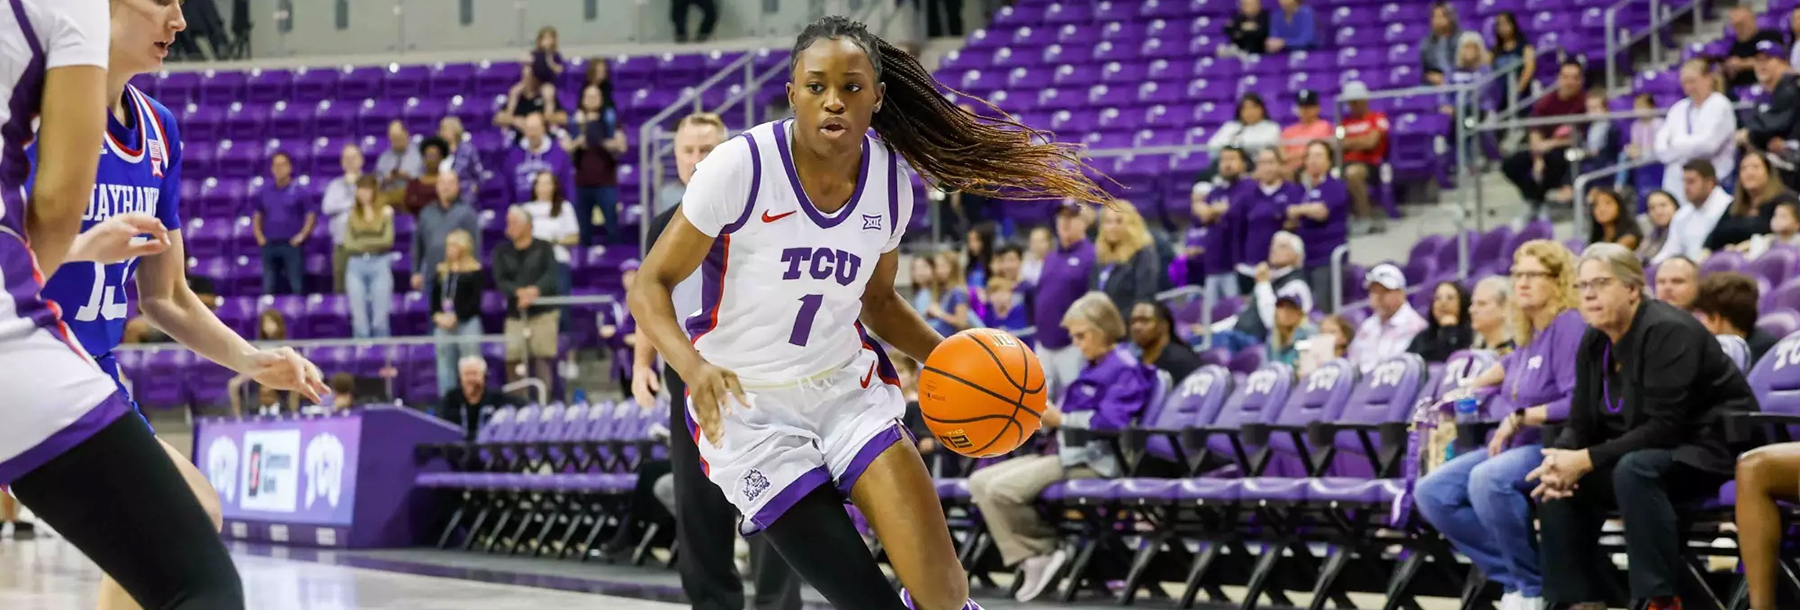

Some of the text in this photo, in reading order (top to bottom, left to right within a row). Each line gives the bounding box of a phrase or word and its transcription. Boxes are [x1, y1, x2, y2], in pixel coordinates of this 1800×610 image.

[780, 247, 862, 287] TCU
[788, 293, 824, 347] 1
[1773, 339, 1800, 372] TC
